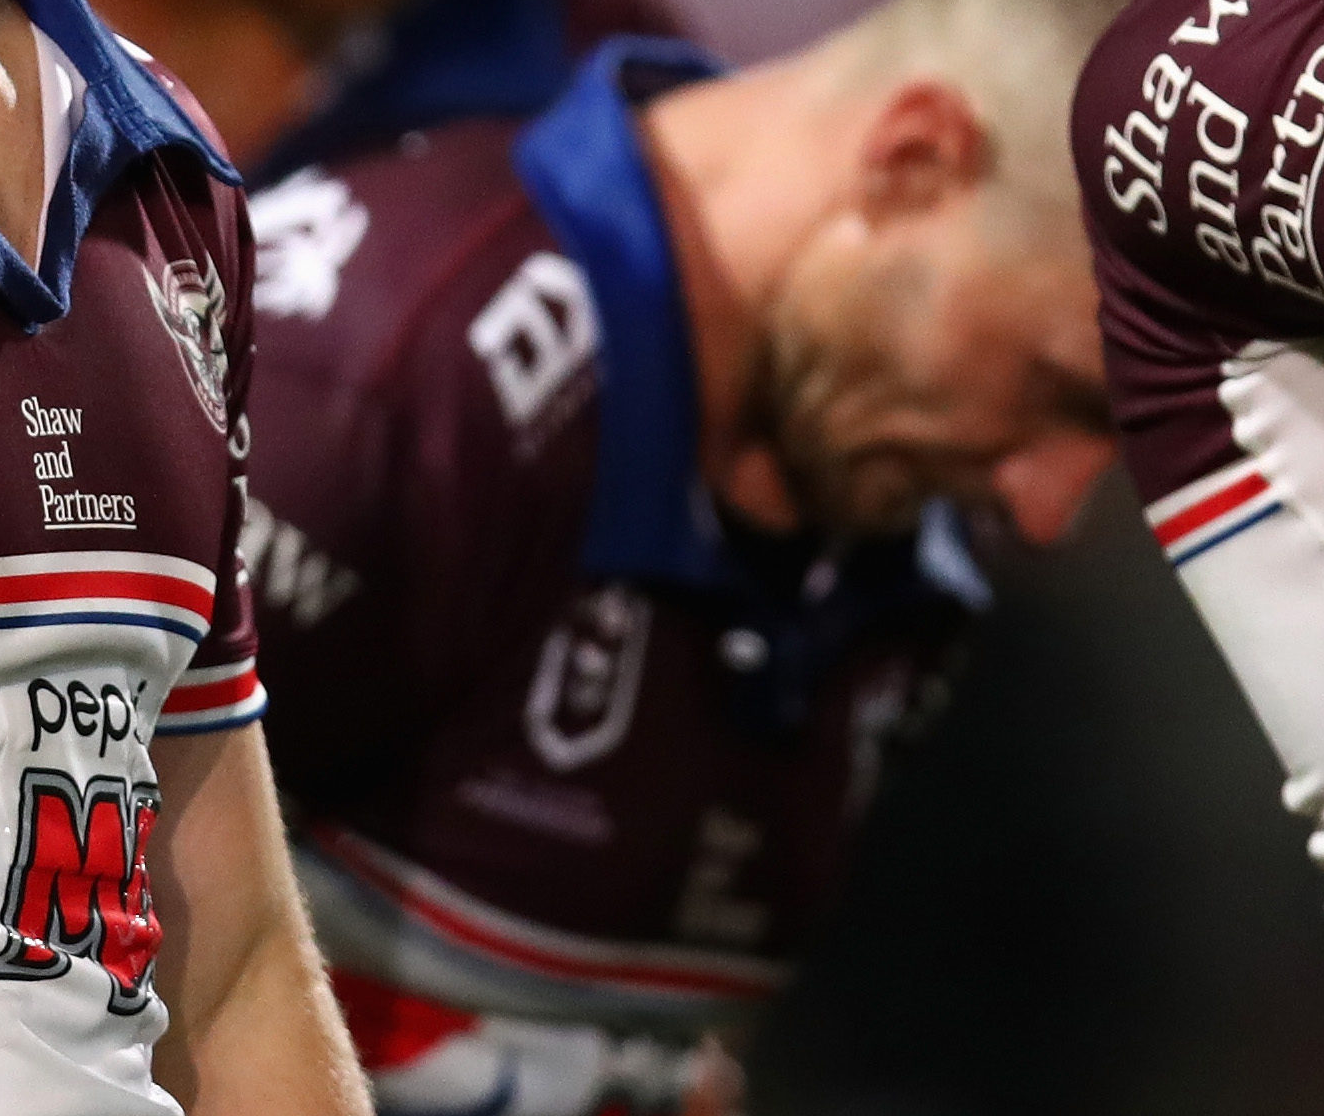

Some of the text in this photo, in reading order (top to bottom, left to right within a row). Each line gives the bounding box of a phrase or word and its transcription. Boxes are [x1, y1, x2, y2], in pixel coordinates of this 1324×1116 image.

[1187, 79, 1250, 276] and
[20, 396, 82, 437] Shaw
[33, 440, 74, 480] and
[38, 484, 137, 523] Partners
